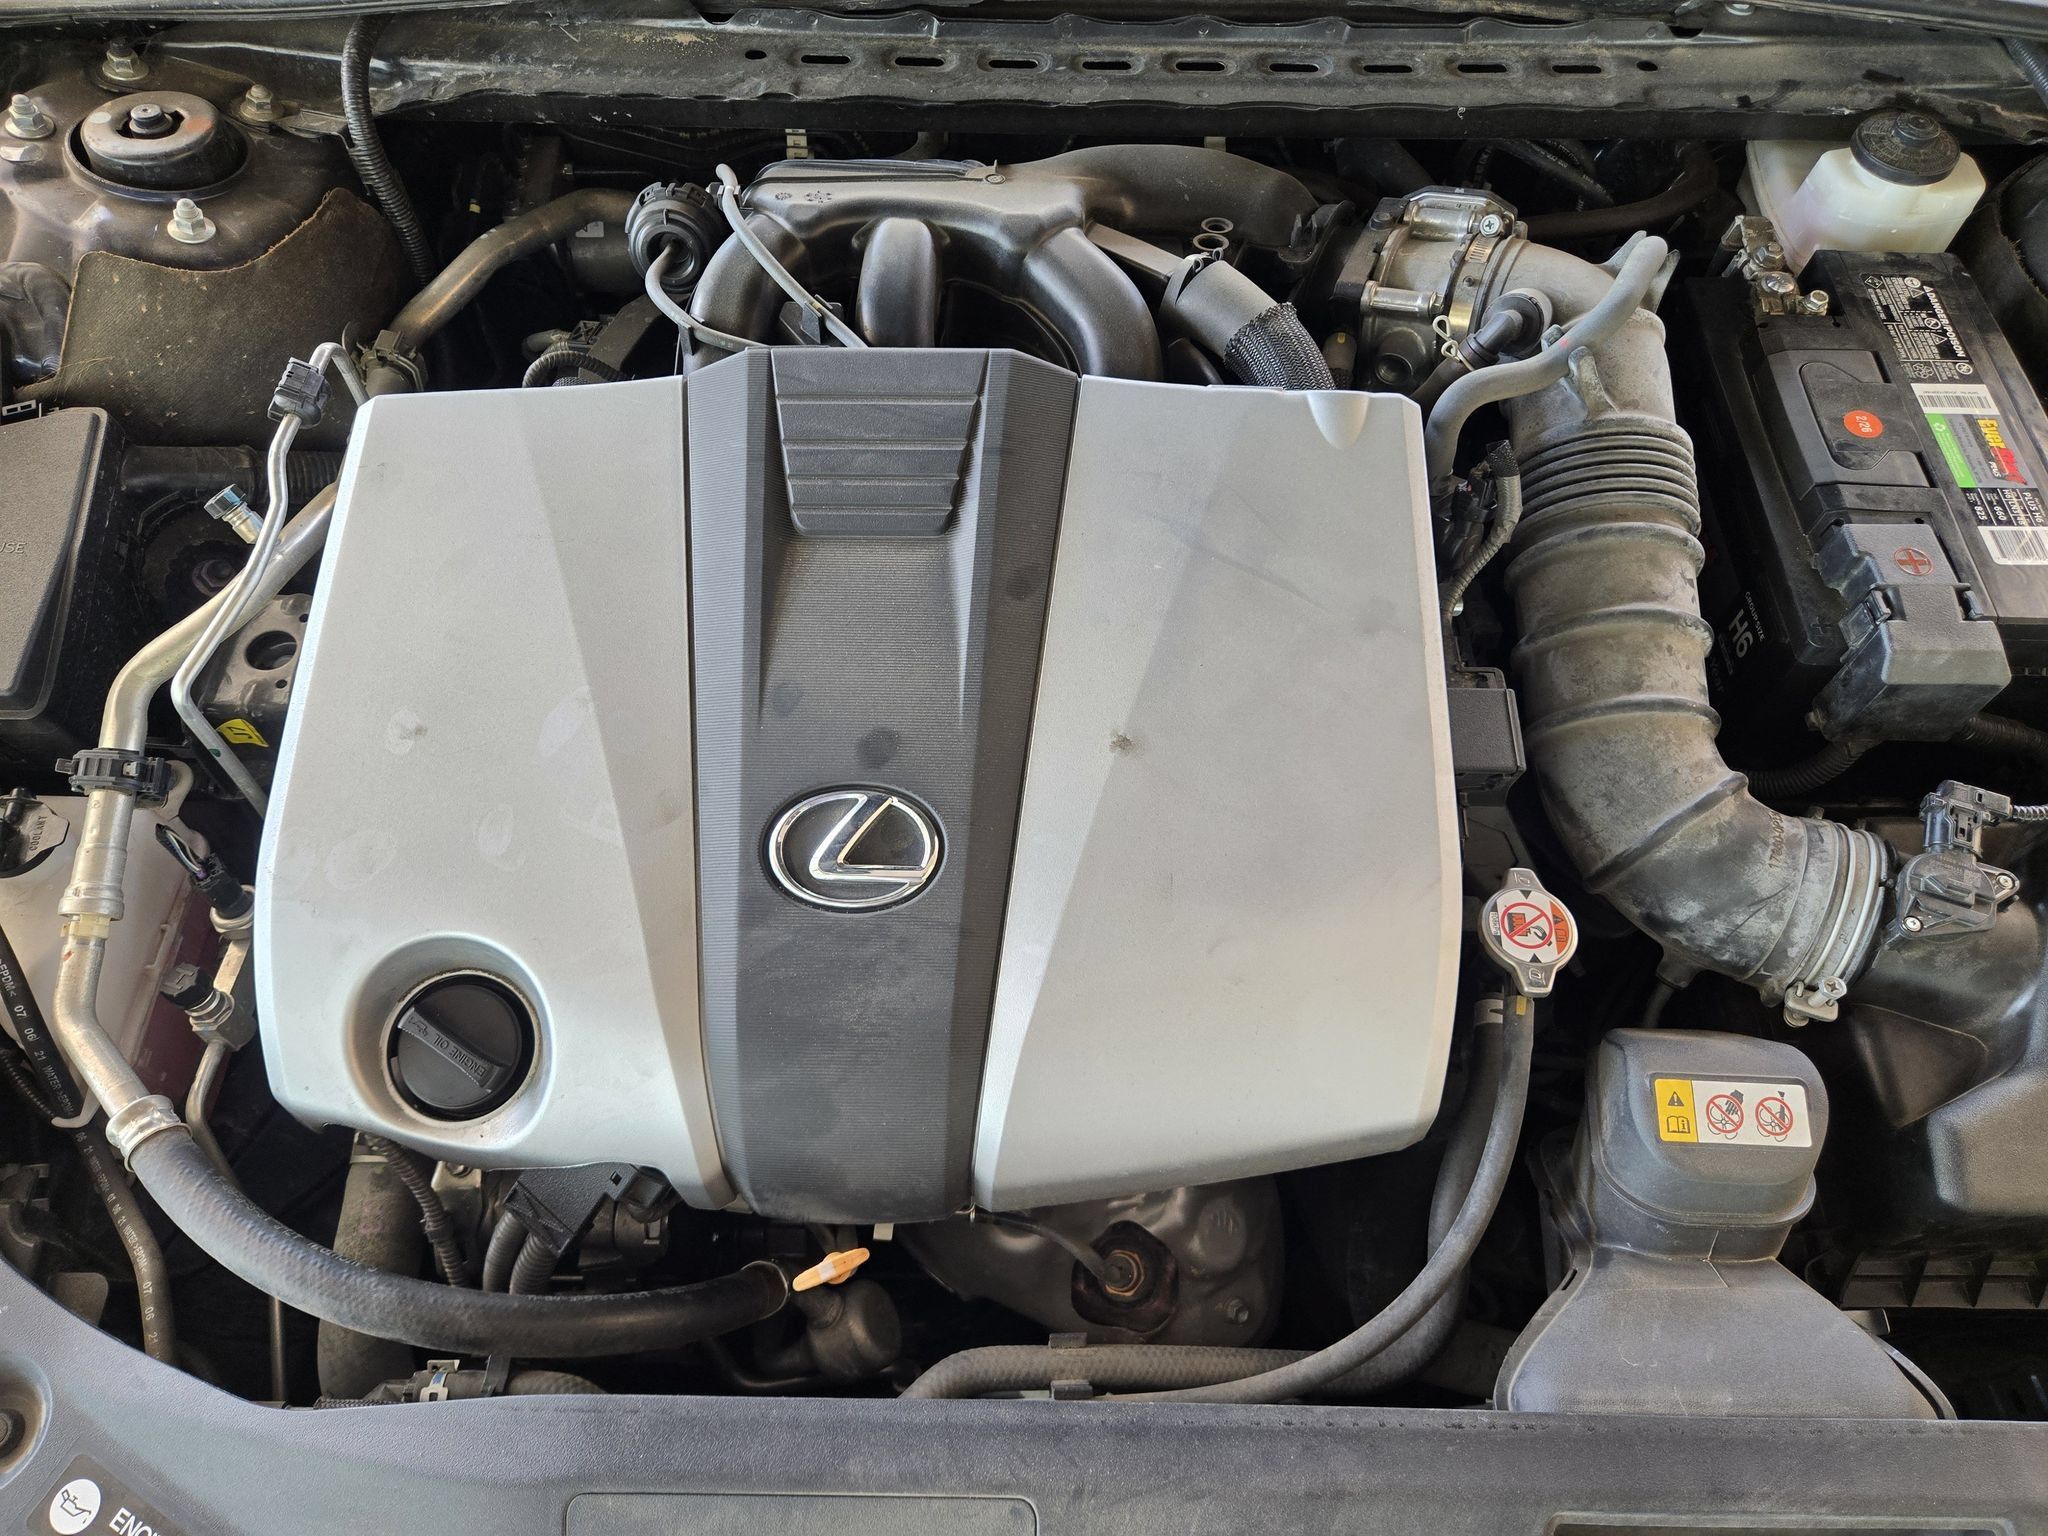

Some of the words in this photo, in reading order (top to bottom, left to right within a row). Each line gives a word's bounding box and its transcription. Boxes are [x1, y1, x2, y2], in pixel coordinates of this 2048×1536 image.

[1974, 505, 1988, 520] 825
[1993, 506, 2008, 521] 660
[2022, 492, 2039, 511] PLUS
[2032, 512, 2045, 523] H6
[1728, 608, 1754, 658] H6
[29, 815, 48, 851] COOLANT
[14, 1004, 27, 1019] 07
[433, 1033, 450, 1050] OIL
[449, 1045, 487, 1077] ENGINE
[142, 1281, 153, 1296] 07
[144, 1306, 155, 1321] 06
